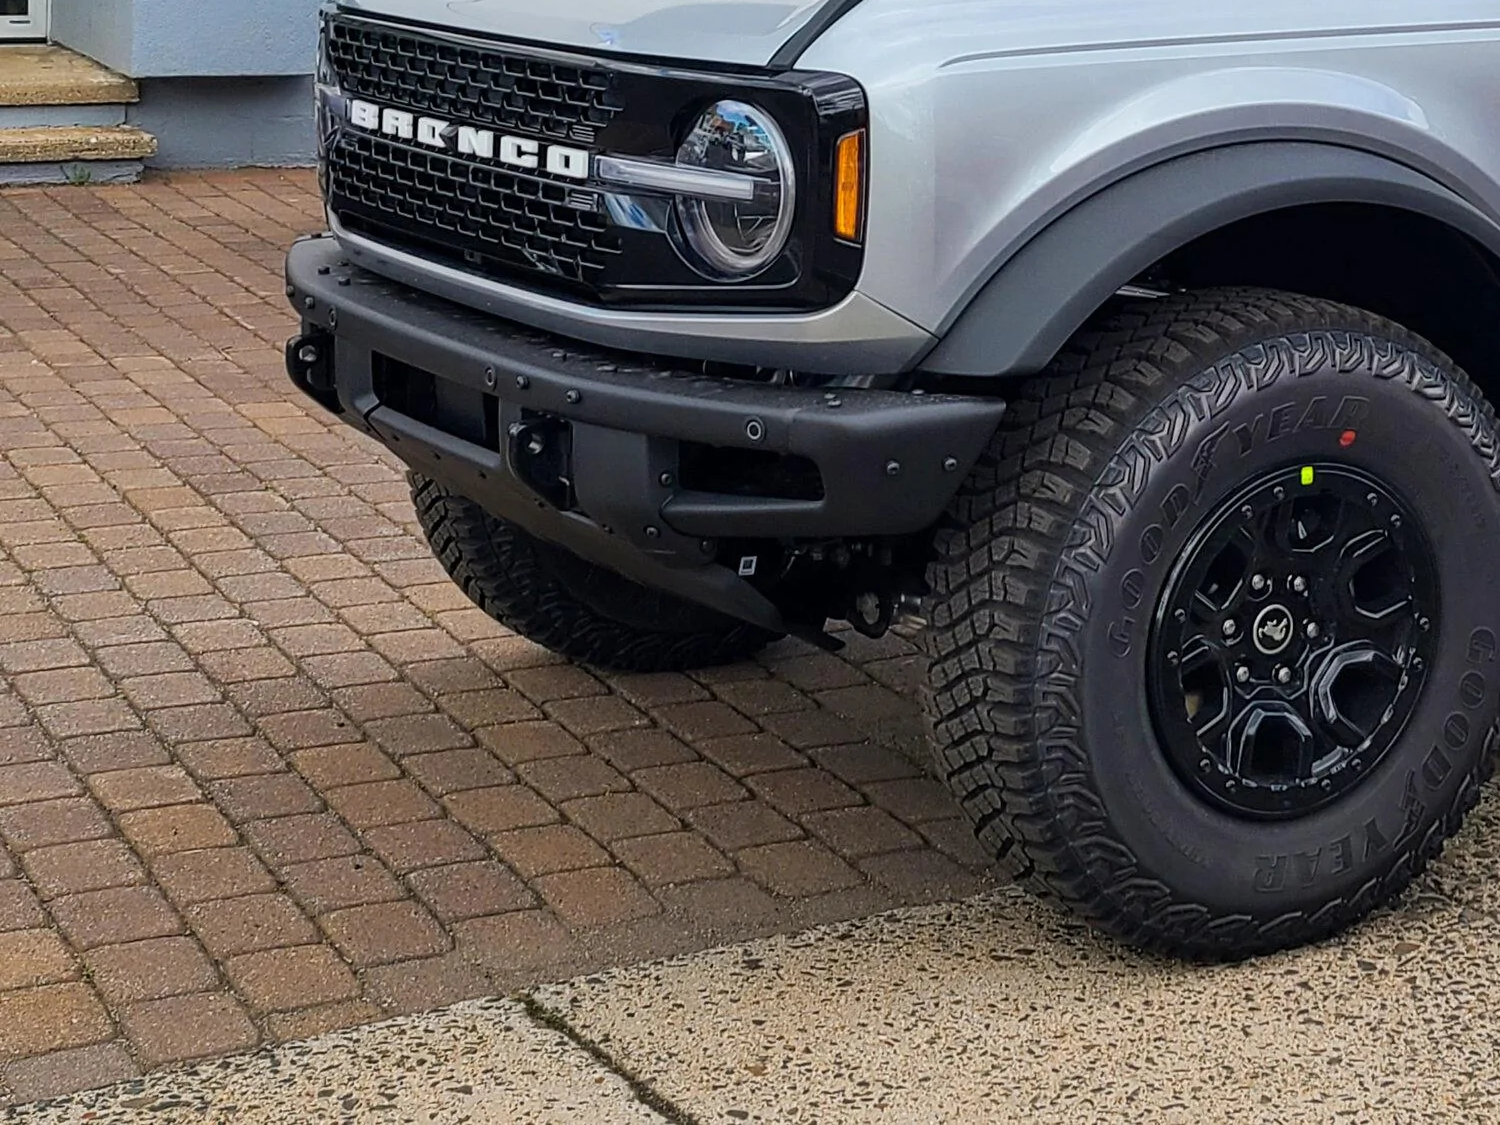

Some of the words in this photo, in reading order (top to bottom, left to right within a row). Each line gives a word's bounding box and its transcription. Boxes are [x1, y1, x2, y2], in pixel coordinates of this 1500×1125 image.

[351, 99, 589, 179] BRONCO
[1107, 395, 1370, 658] GOODYEAR
[1254, 626, 1496, 892] GOODYEAR
